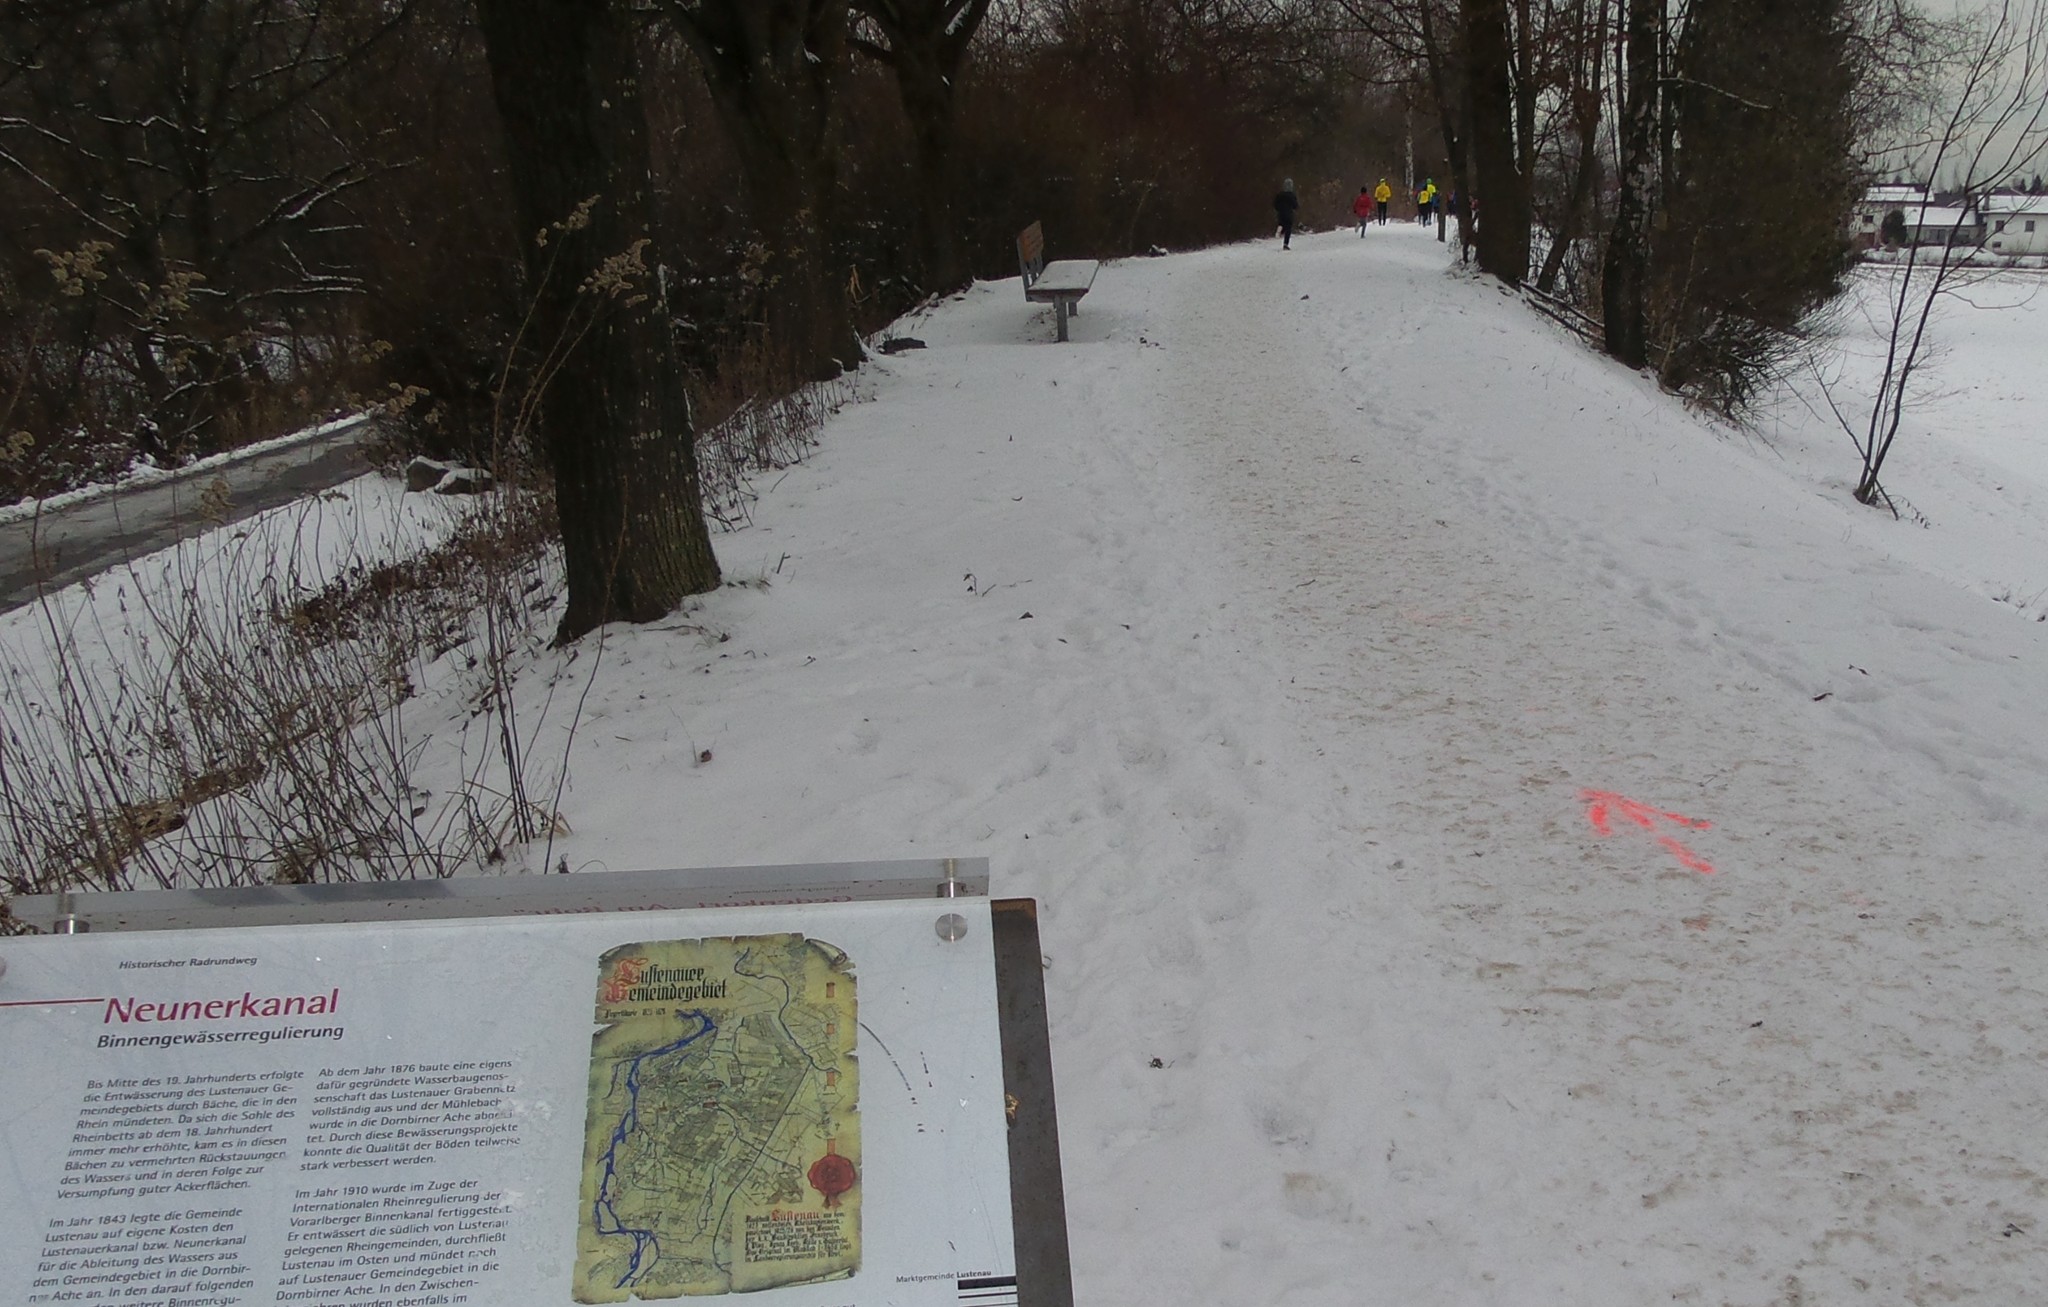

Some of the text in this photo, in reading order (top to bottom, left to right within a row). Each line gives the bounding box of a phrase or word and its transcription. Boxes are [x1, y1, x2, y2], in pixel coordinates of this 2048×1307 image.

[119, 957, 258, 969] Historischer Radrundweg
[104, 988, 339, 1024] Neunerkanal
[97, 1025, 344, 1049] Binnengewässerregulierung
[336, 1060, 512, 1076] dem Jahr 1876 baute eine eigens
[86, 1070, 304, 1089] Bis Mitte des 19. Jahrhunderts erfolgte
[316, 1073, 509, 1090] dafür gegründete Wasserbaugenos-
[83, 1083, 293, 1102] die Entwässerung des Lustenauer Ge-
[313, 1089, 451, 1104] senschaft das Lustenauer
[79, 1096, 297, 1116] meindegebiets durch Bäche, die den
[311, 1097, 502, 1116] vollständig aus und der Mühlebach
[75, 1109, 295, 1129] Rhein mündeten. sich die Sohle des
[309, 1112, 471, 1130] wurde die Dornbirner Ache
[71, 1124, 273, 1143] Rheinbetts dem 18. Jahrhundert
[306, 1123, 518, 1143] tet. Durch diese Bewässerungsprojekte
[67, 1136, 287, 1157] immer mehr erhöhte, kam diesen
[303, 1147, 343, 1157] konnte
[345, 1145, 363, 1155] die
[365, 1142, 410, 1154] Qualität
[413, 1141, 432, 1151] der
[435, 1139, 470, 1149] Böden
[64, 1151, 286, 1171] Bächen vermehrten Rückstauungen
[299, 1154, 436, 1171] stark verbessert werden.
[59, 1166, 264, 1185] des Wassers und deren Folge zur
[57, 1179, 251, 1199] Versumpfung guter Ackerflächen.
[312, 1179, 478, 1198] Jahr 1910 wurde Zuge der
[292, 1191, 501, 1213] Internationalen Rheinregulierung der
[66, 1207, 243, 1227] Jahr 1843 legte die Gemeinde
[289, 1208, 434, 1227] Vorarlberger Binnenkanal
[44, 1222, 234, 1243] Lustenau auf eigene Kosten den
[302, 1228, 366, 1241] entwässert
[369, 1226, 386, 1236] die
[388, 1223, 429, 1235] südlich
[433, 1223, 455, 1232] von
[41, 1234, 247, 1257] Lustenauerkanal bzw. Neunerkanal
[284, 1231, 506, 1258] gelegenen Rheingemeinden, durchfließt
[37, 1251, 238, 1272] für die Ableitung des Wassers aus
[281, 1249, 464, 1271] Lustenau Osten und mündet
[32, 1263, 251, 1288] dem Gemeindegebiet die Dornbir-
[278, 1261, 499, 1286] auf Lustenauer Gemeindegebiet in die
[896, 1270, 992, 1283] Marktgemeinde Lustenau
[50, 1278, 254, 1301] Ache an. den darauf folgenden
[275, 1278, 479, 1301] Dornbirner Ache. den Zwischen-
[396, 1294, 449, 1307] ebenfalls
[452, 1293, 467, 1303] im
